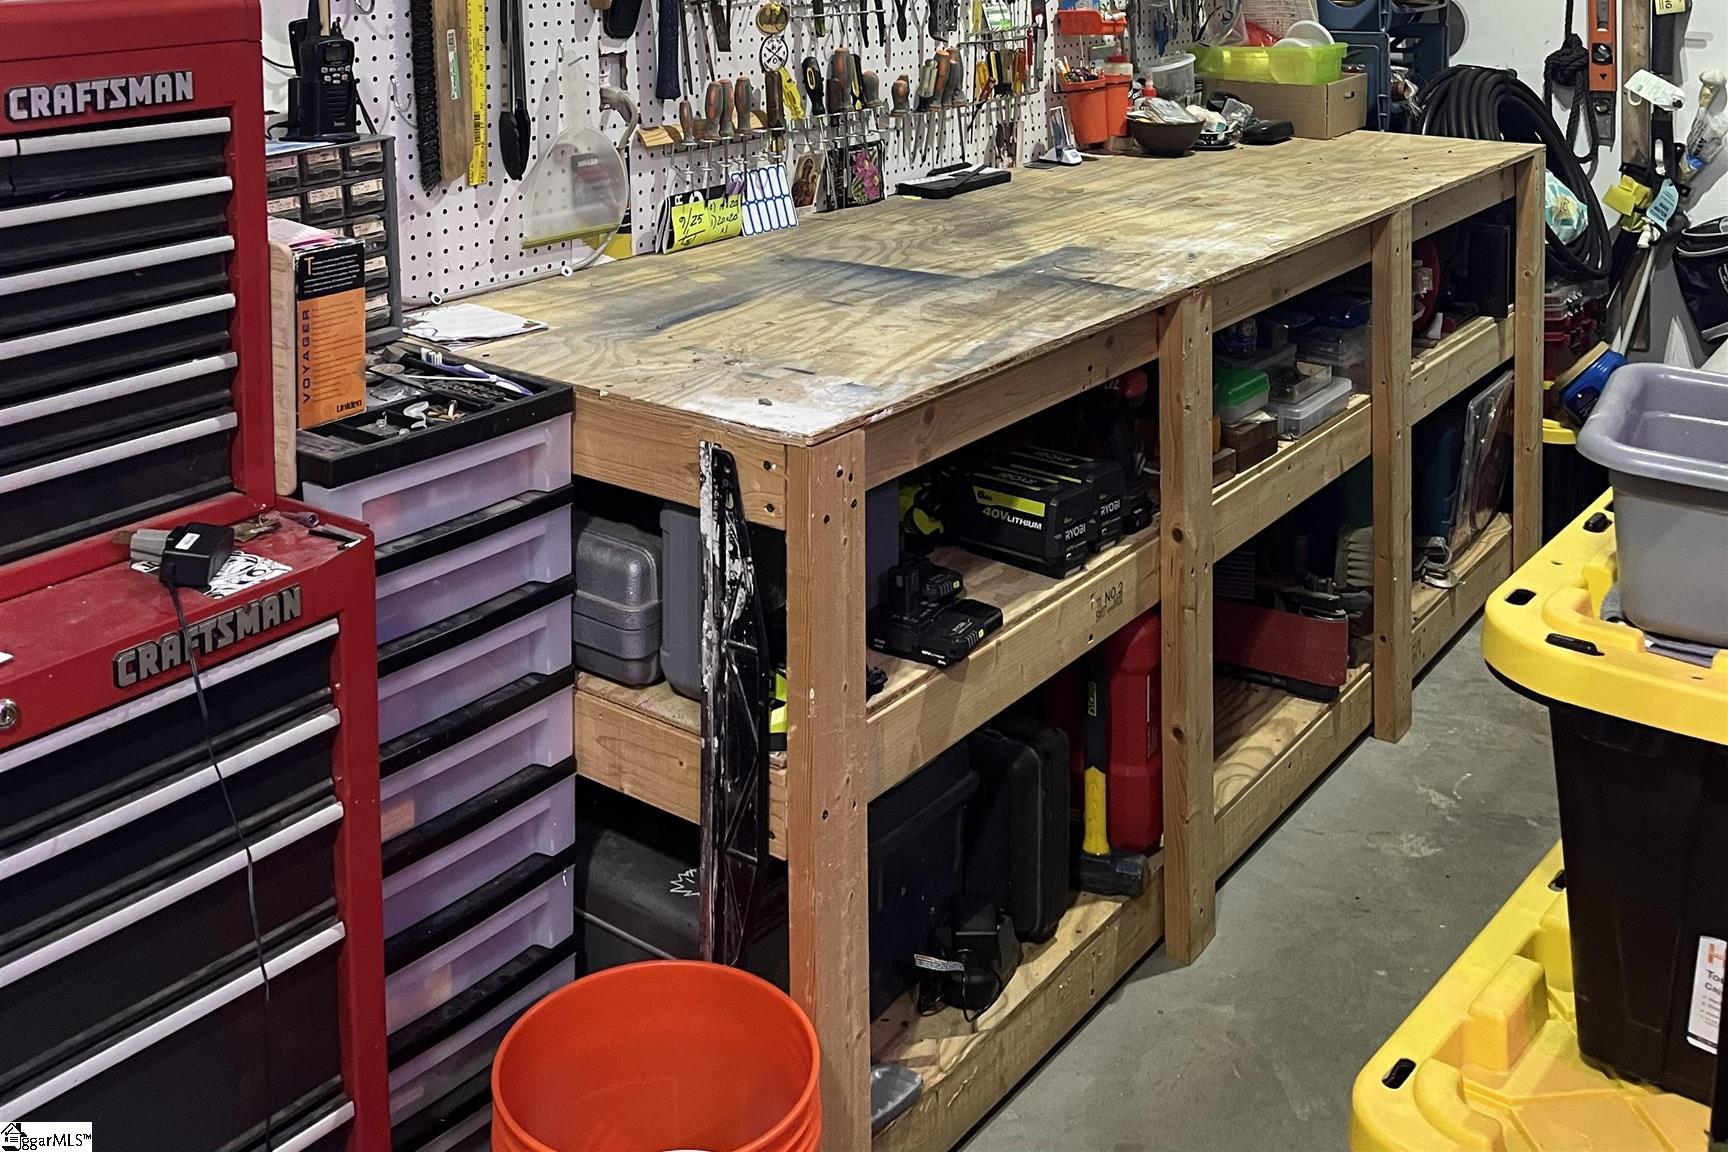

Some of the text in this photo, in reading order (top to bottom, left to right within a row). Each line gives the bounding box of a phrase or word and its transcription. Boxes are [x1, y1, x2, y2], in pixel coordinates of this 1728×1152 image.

[9, 71, 193, 120] CRAFTSMAN
[302, 308, 310, 404] VOYAGER
[336, 399, 362, 413] Uniden
[1100, 499, 1120, 516] RYOBI
[1007, 515, 1043, 531] LITHIUM
[1065, 522, 1086, 541] RYOBI
[117, 586, 302, 688] CRAFTSMAN
